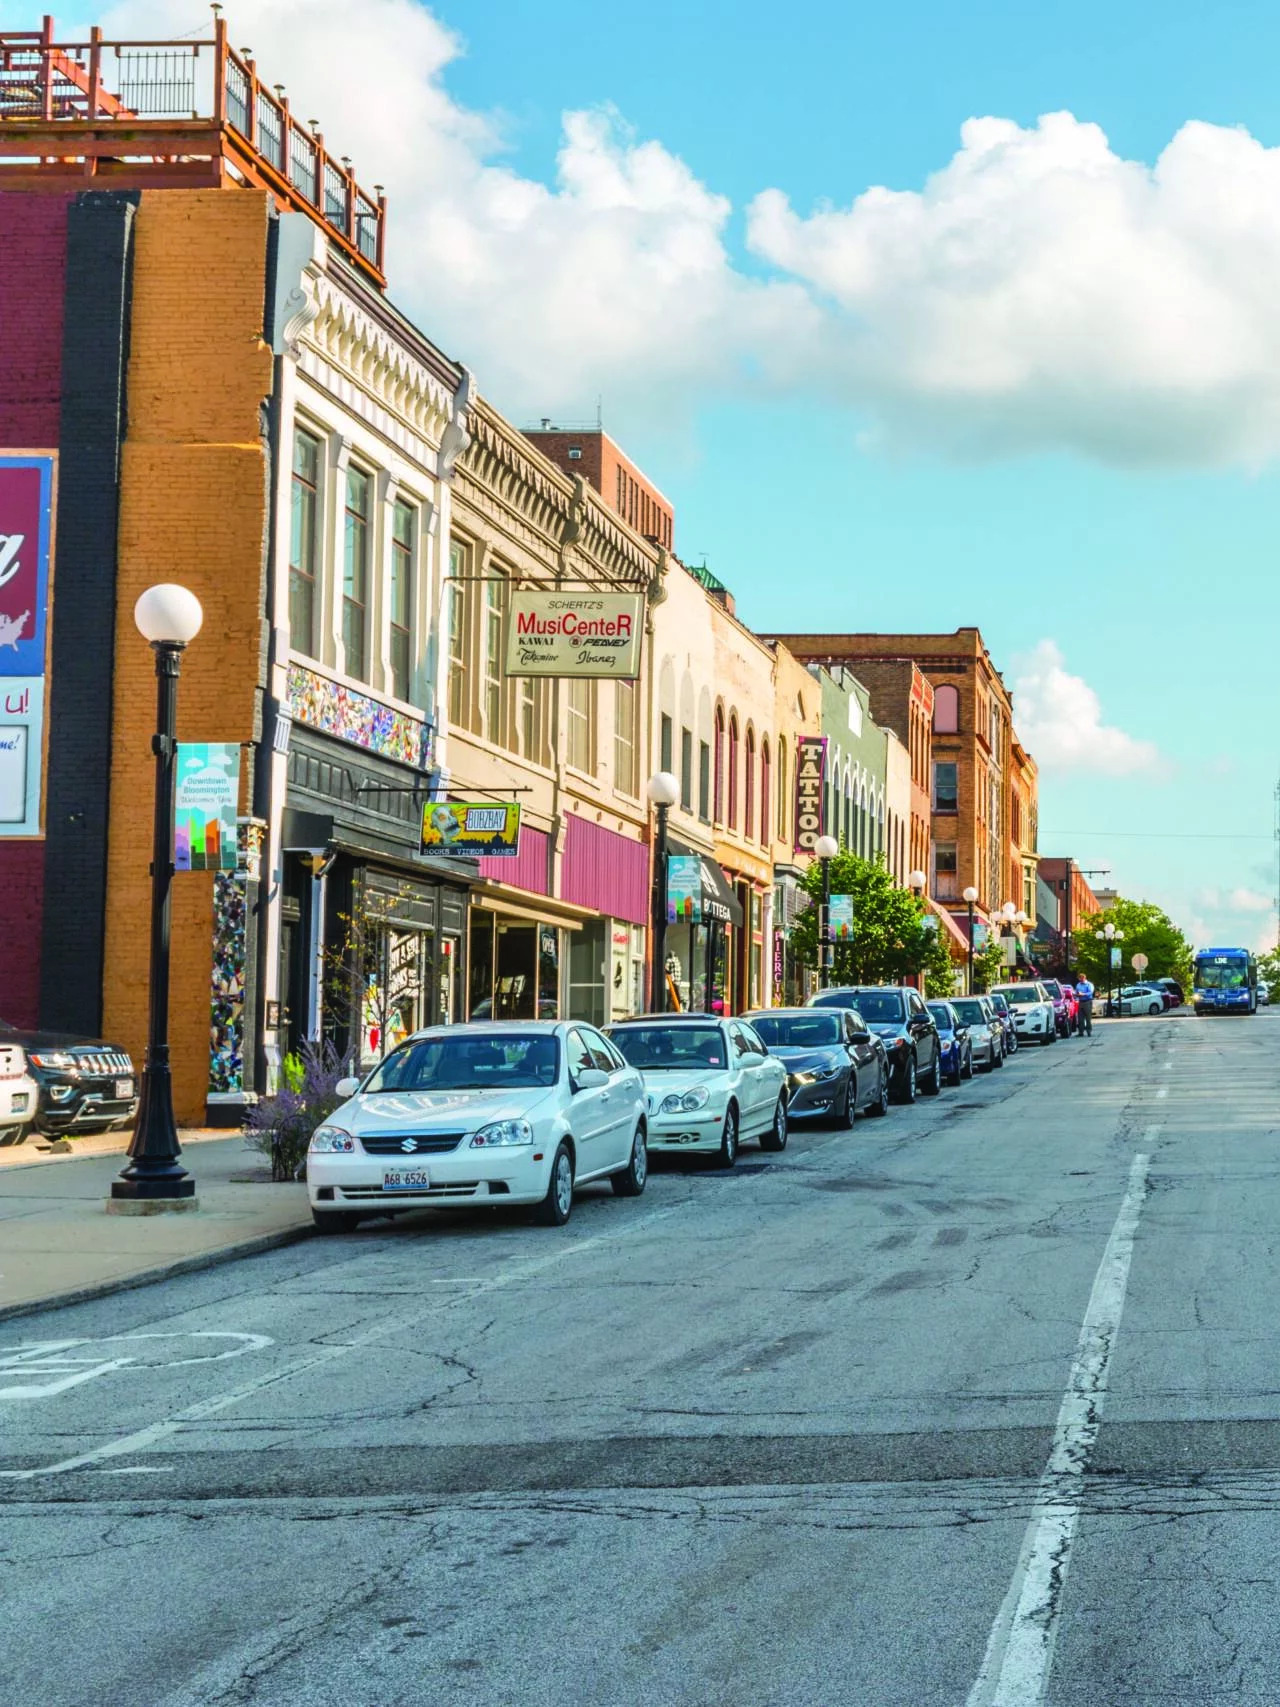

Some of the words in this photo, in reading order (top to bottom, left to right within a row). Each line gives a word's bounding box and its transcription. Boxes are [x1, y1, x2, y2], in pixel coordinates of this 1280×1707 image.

[548, 600, 604, 610] SCHERTZ'S
[517, 612, 632, 636] MusiCenteR
[518, 637, 554, 646] KAWAI
[583, 638, 630, 647] PEAVEY
[517, 647, 559, 665] Takamine
[576, 650, 616, 667] Ibanez
[187, 776, 227, 785] Downtown
[183, 785, 230, 794] Bloomington
[799, 744, 824, 848] TATTOO
[703, 898, 731, 921] BOTTEGA
[405, 1172, 427, 1185] 6526
